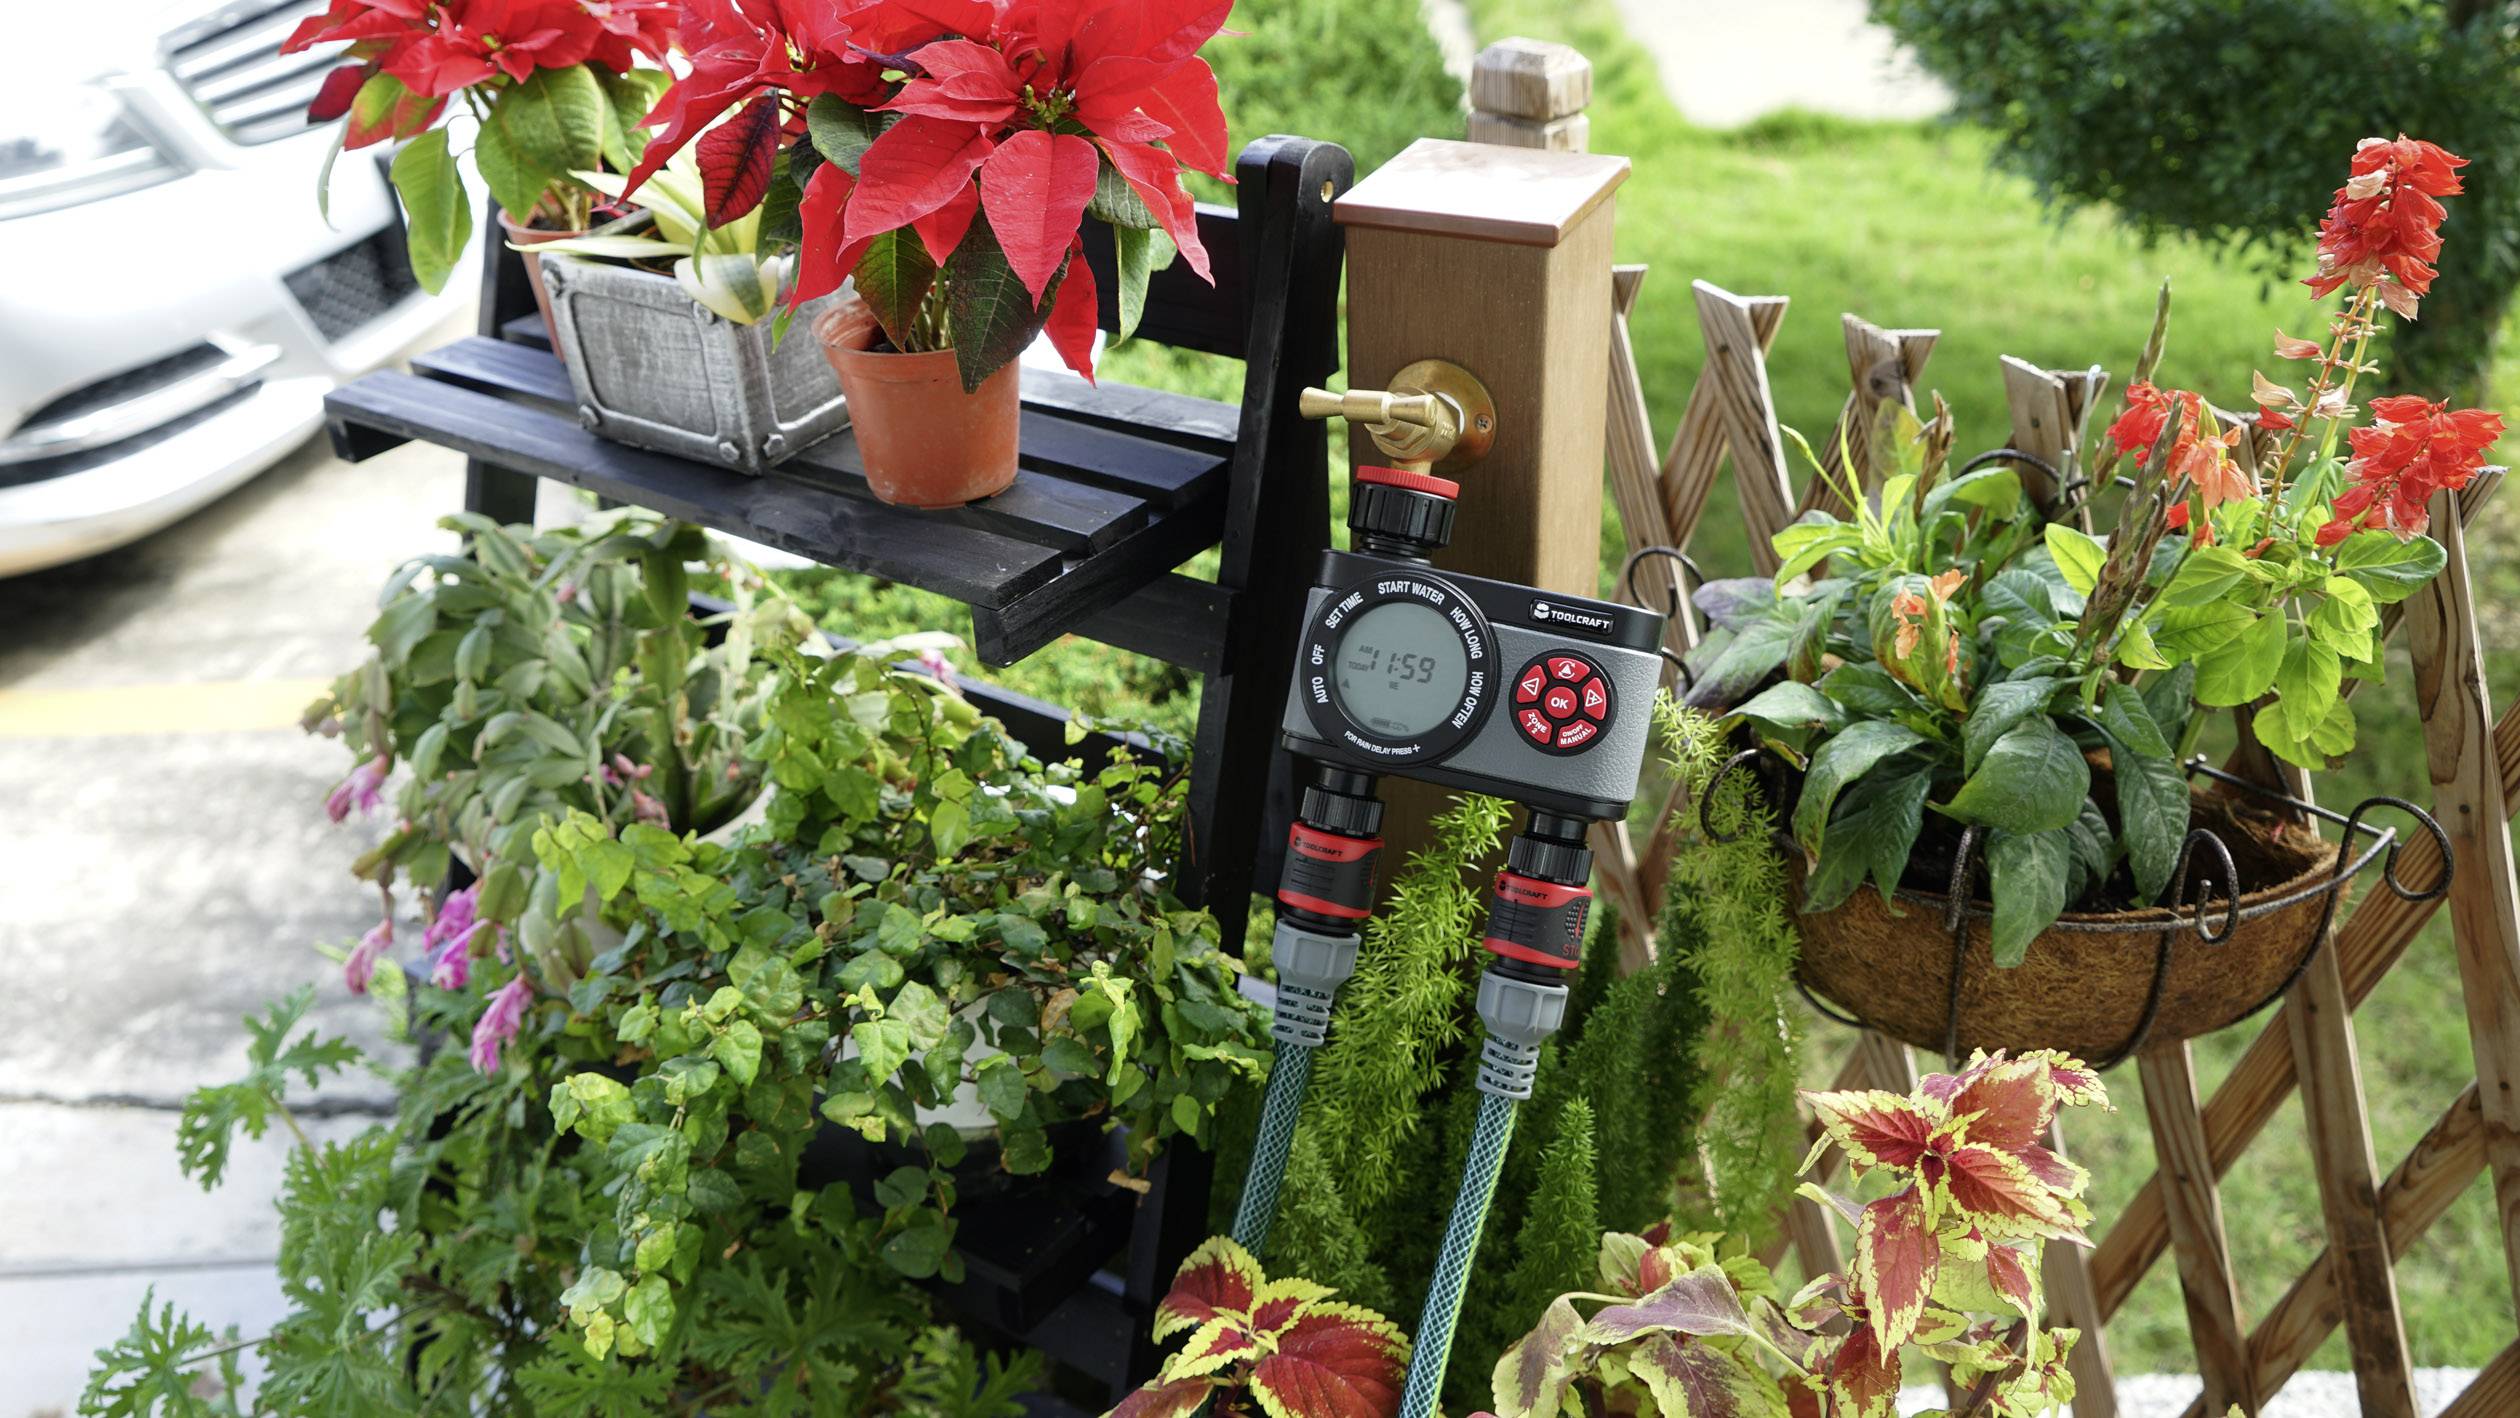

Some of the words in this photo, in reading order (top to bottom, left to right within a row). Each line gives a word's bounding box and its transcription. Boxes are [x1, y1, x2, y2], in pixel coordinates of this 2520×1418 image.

[1378, 581, 1410, 594] START
[1412, 582, 1445, 605] WATER
[1325, 608, 1343, 628] SET
[1339, 592, 1364, 612] TIME
[1551, 610, 1609, 628] TOOLCRAFT
[1450, 606, 1472, 630] HOW
[1464, 629, 1483, 659] LONG
[1311, 644, 1325, 665] OFF
[1348, 661, 1370, 672] TODAY
[1370, 649, 1436, 684] 11:59
[1311, 676, 1329, 703] AUTO
[1469, 671, 1484, 697] HOW
[1451, 696, 1477, 729] OFTEN
[1550, 697, 1569, 709] OK
[1528, 712, 1547, 733] ZONE
[1562, 723, 1583, 738] ON/OFF
[1344, 730, 1358, 744] FOR
[1356, 738, 1371, 750] RAIN
[1371, 744, 1391, 755] DELAY
[1391, 746, 1412, 755] PRESS
[1560, 728, 1592, 745] MANUAL
